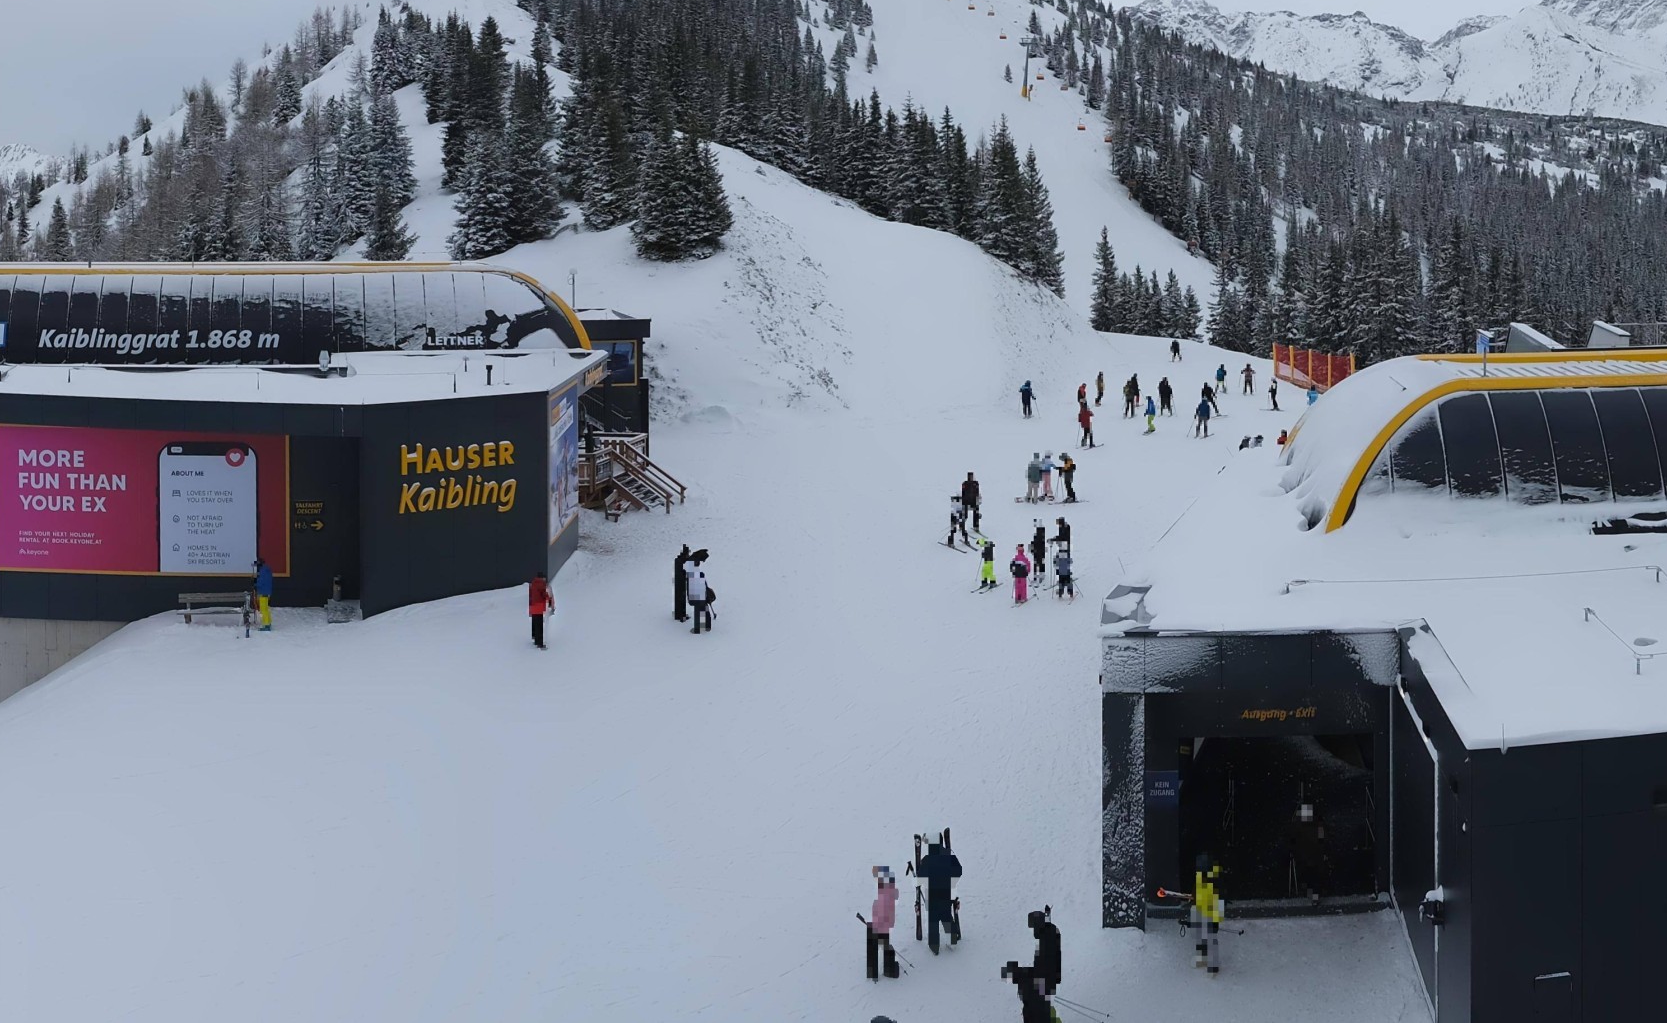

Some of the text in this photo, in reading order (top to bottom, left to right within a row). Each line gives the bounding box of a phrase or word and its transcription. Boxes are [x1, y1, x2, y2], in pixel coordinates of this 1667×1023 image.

[37, 328, 280, 354] Kaiblinggrat 1.868 m
[427, 336, 484, 346] LEITNER
[18, 449, 84, 468] MORE
[400, 440, 515, 475] HAUSER
[18, 472, 126, 490] FUN THAN
[20, 495, 107, 512] YOUR EX
[399, 475, 517, 514] Kaibling
[26, 548, 49, 556] keyone
[1242, 709, 1287, 721] Ausgang
